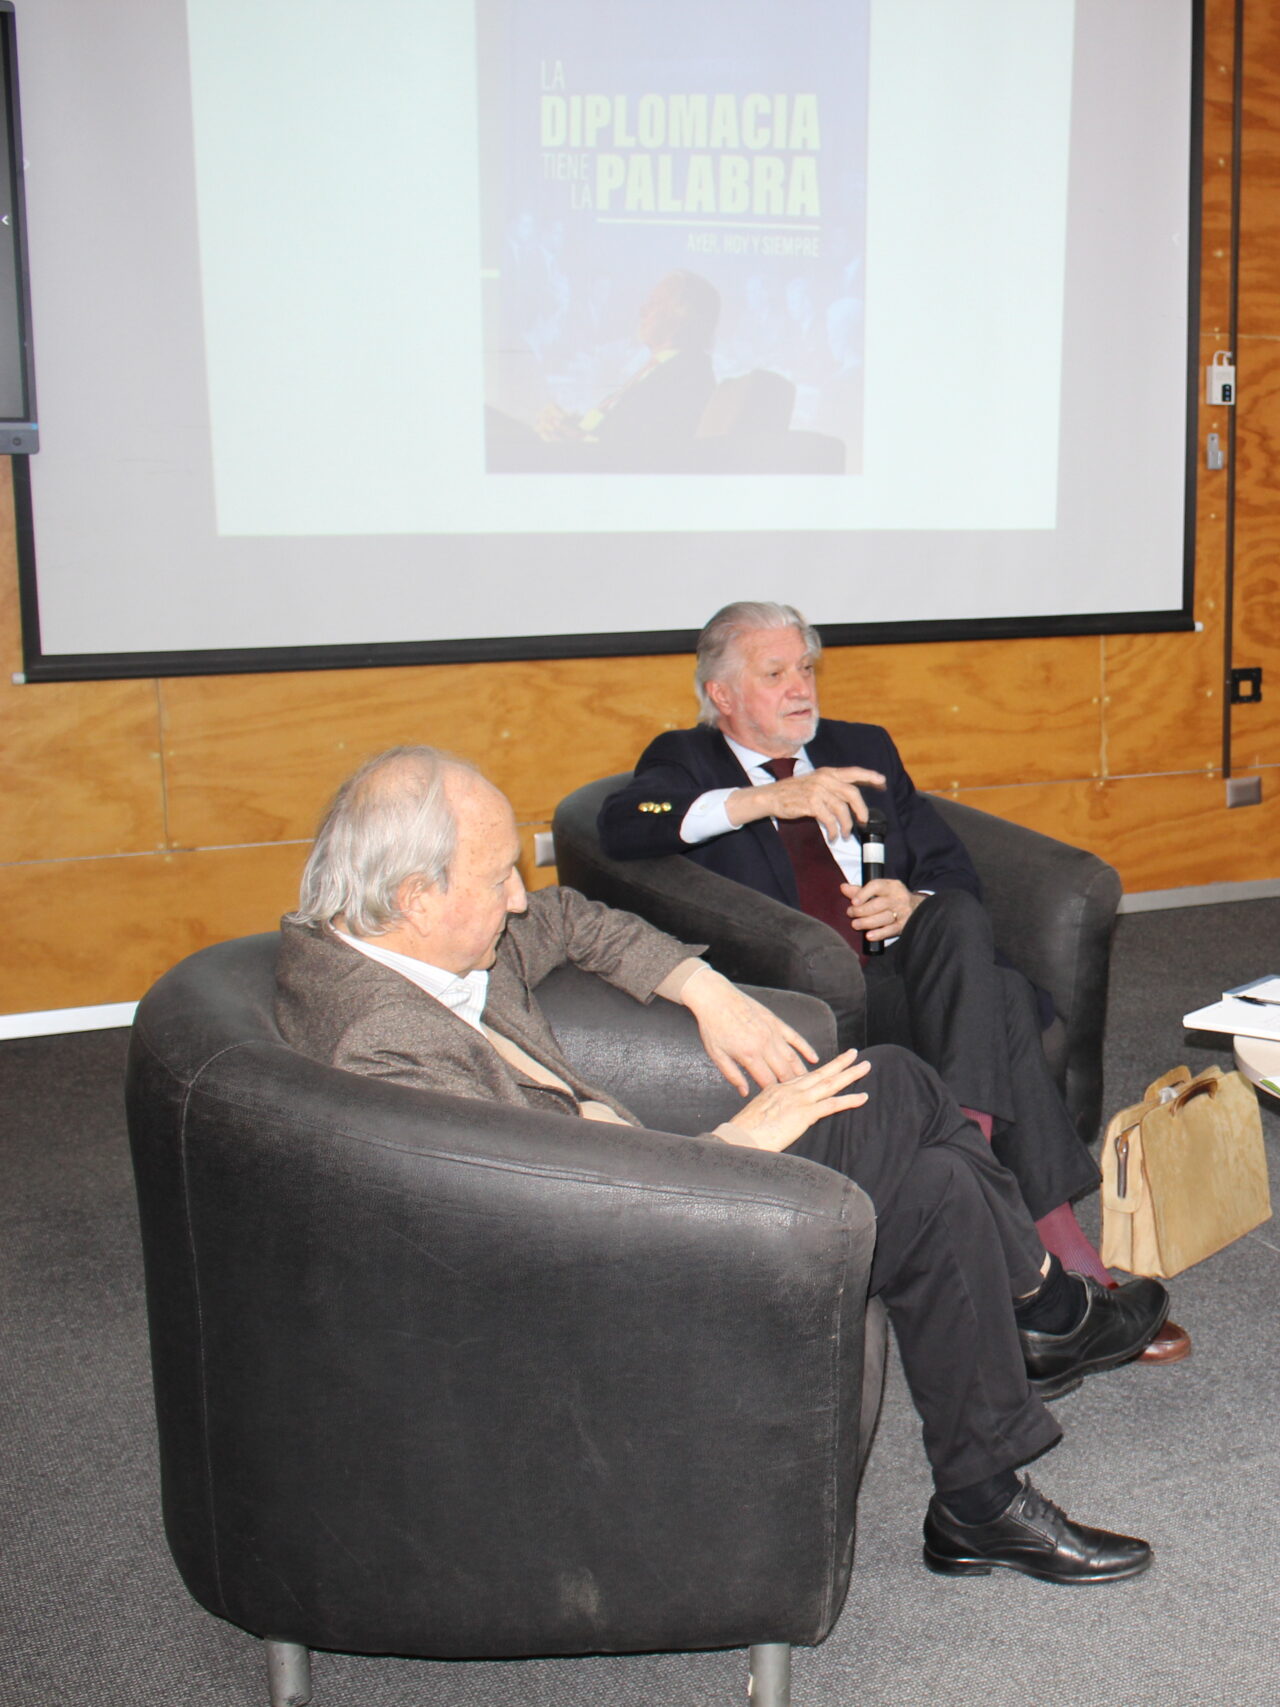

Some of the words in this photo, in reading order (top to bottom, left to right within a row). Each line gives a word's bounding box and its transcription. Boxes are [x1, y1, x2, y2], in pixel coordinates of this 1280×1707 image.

[540, 59, 566, 91] LA
[541, 93, 821, 151] DIPLOMACIA
[541, 152, 590, 181] TIENE
[571, 183, 593, 210] LA
[595, 154, 821, 217] PALABRA
[762, 235, 820, 258] SIEMPRE
